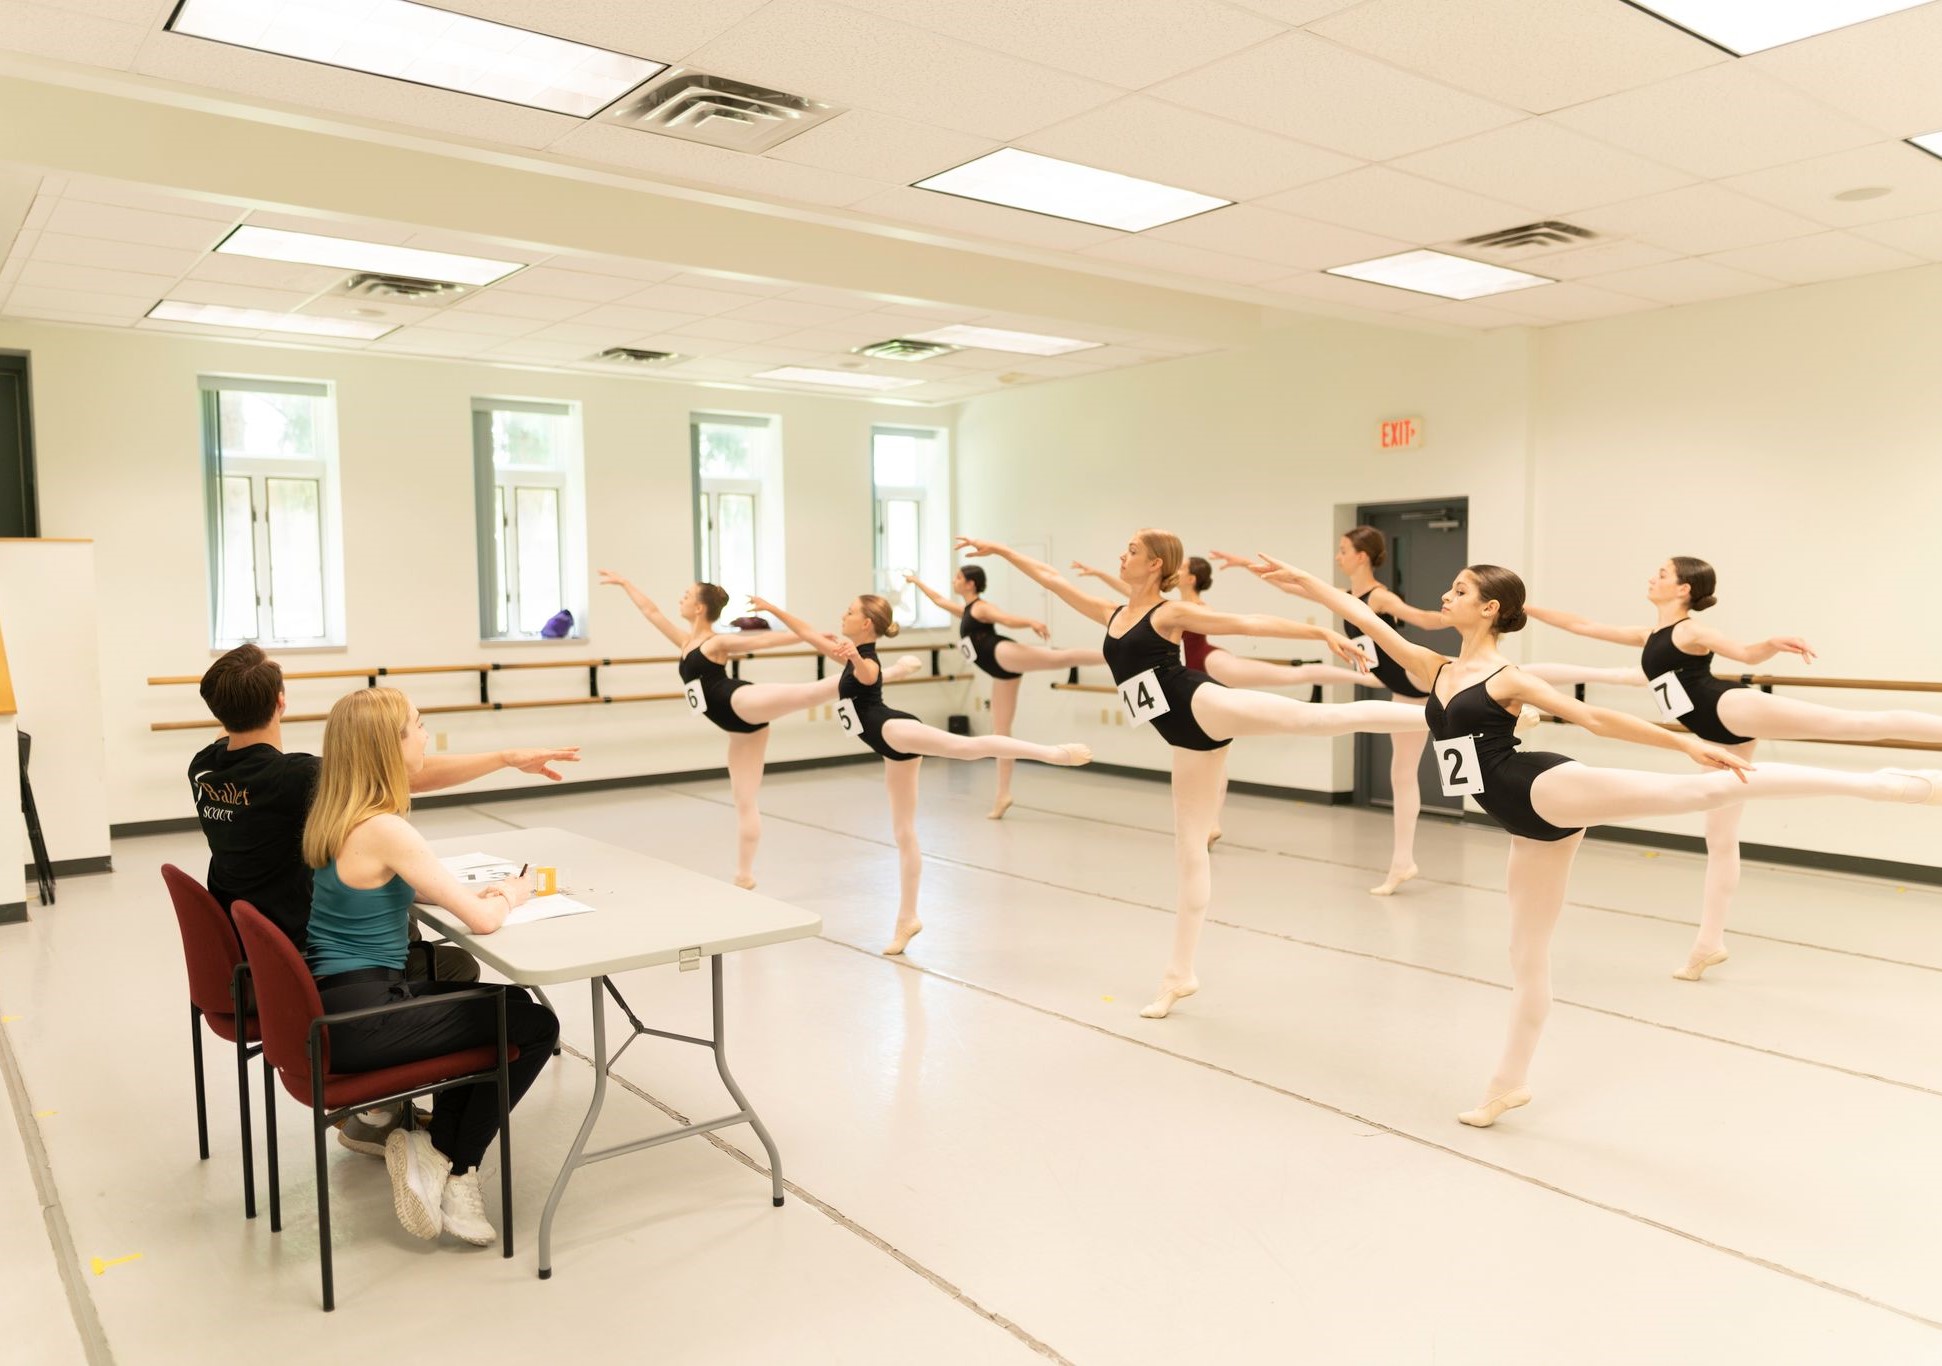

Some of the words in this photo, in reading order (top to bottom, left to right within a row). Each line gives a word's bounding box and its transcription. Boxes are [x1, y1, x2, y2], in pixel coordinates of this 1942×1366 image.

[1381, 420, 1411, 448] EXIT
[687, 688, 698, 709] 6
[1123, 681, 1155, 718] 14
[1653, 682, 1672, 710] 7
[837, 706, 852, 730] 5
[1443, 748, 1468, 785] 2
[200, 782, 251, 806] Ballet
